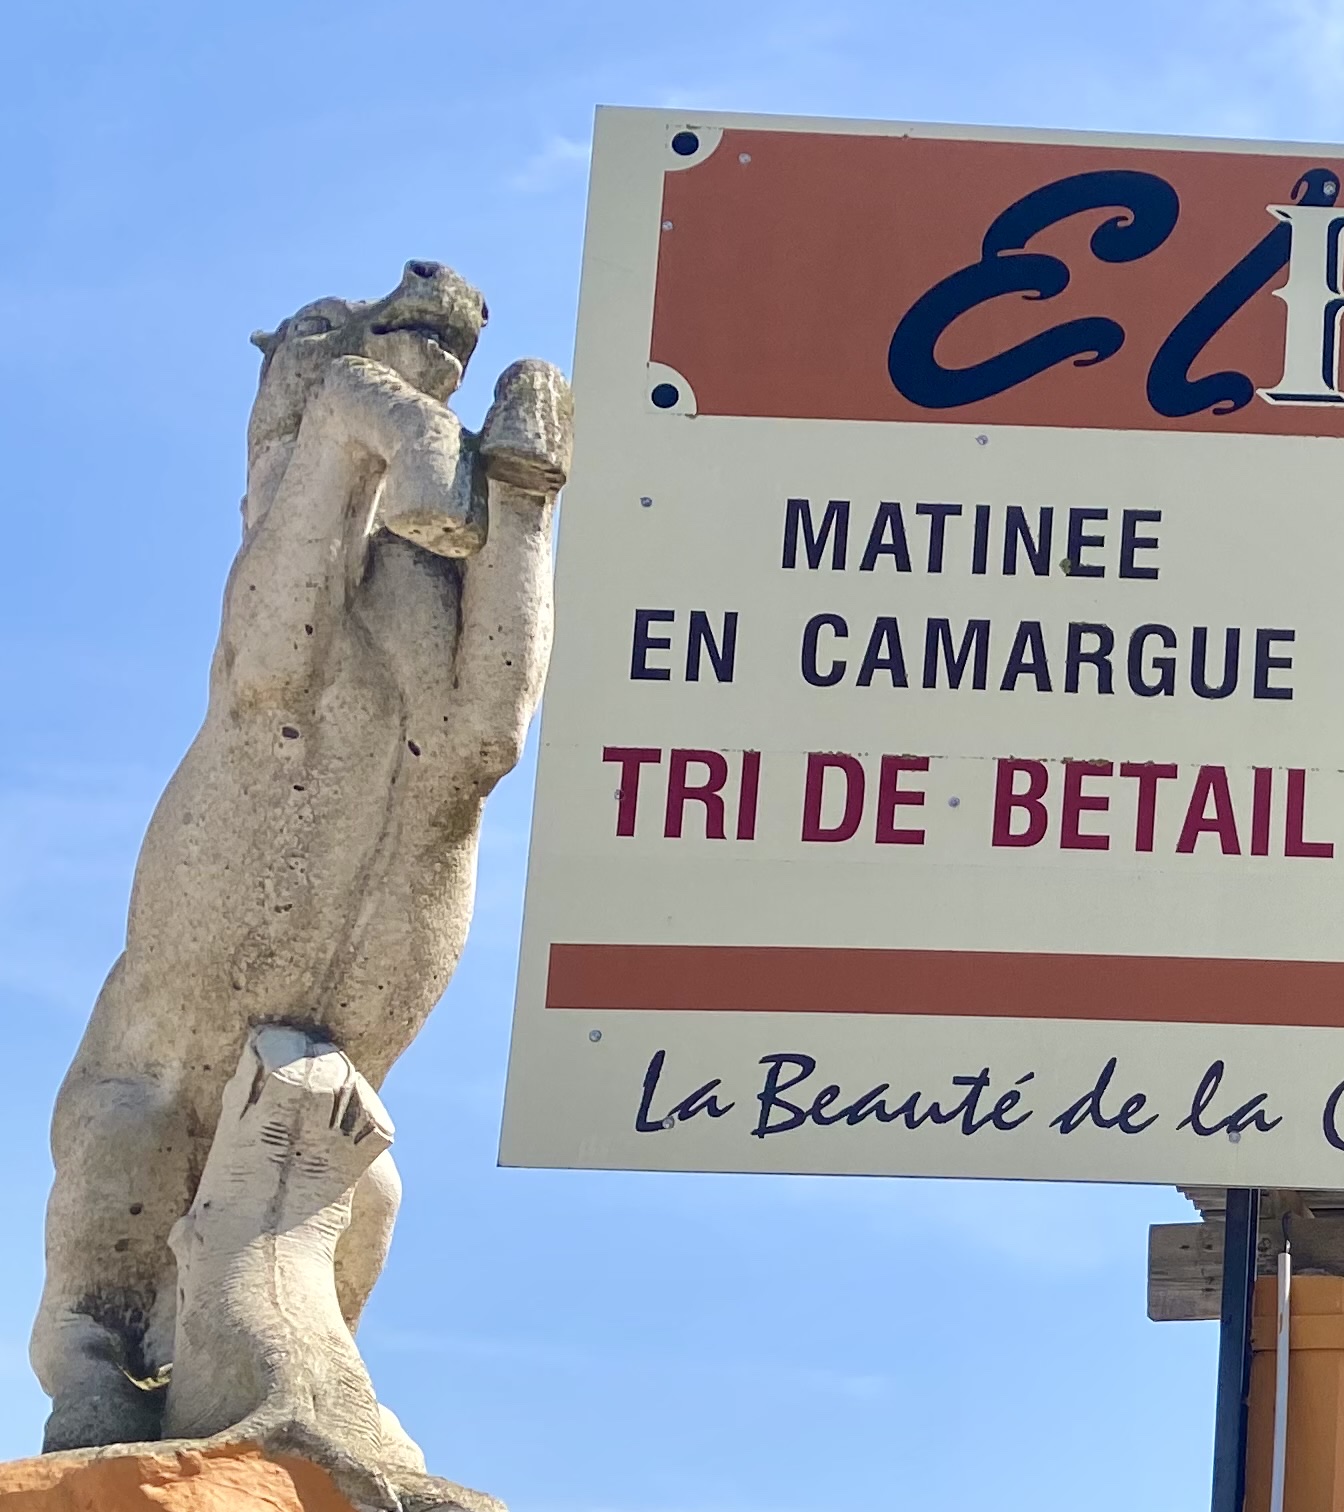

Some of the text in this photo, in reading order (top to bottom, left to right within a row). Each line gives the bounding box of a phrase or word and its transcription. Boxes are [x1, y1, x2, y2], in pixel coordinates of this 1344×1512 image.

[888, 168, 1340, 417] El
[781, 498, 1162, 580] MATINEE
[630, 609, 1296, 701] EN CAMARGUE
[602, 746, 1335, 859] TRI DE BETAIL
[635, 1050, 735, 1131] La
[754, 1053, 1035, 1139] Beauté
[1050, 1057, 1157, 1136] de
[1175, 1061, 1282, 1134] la
